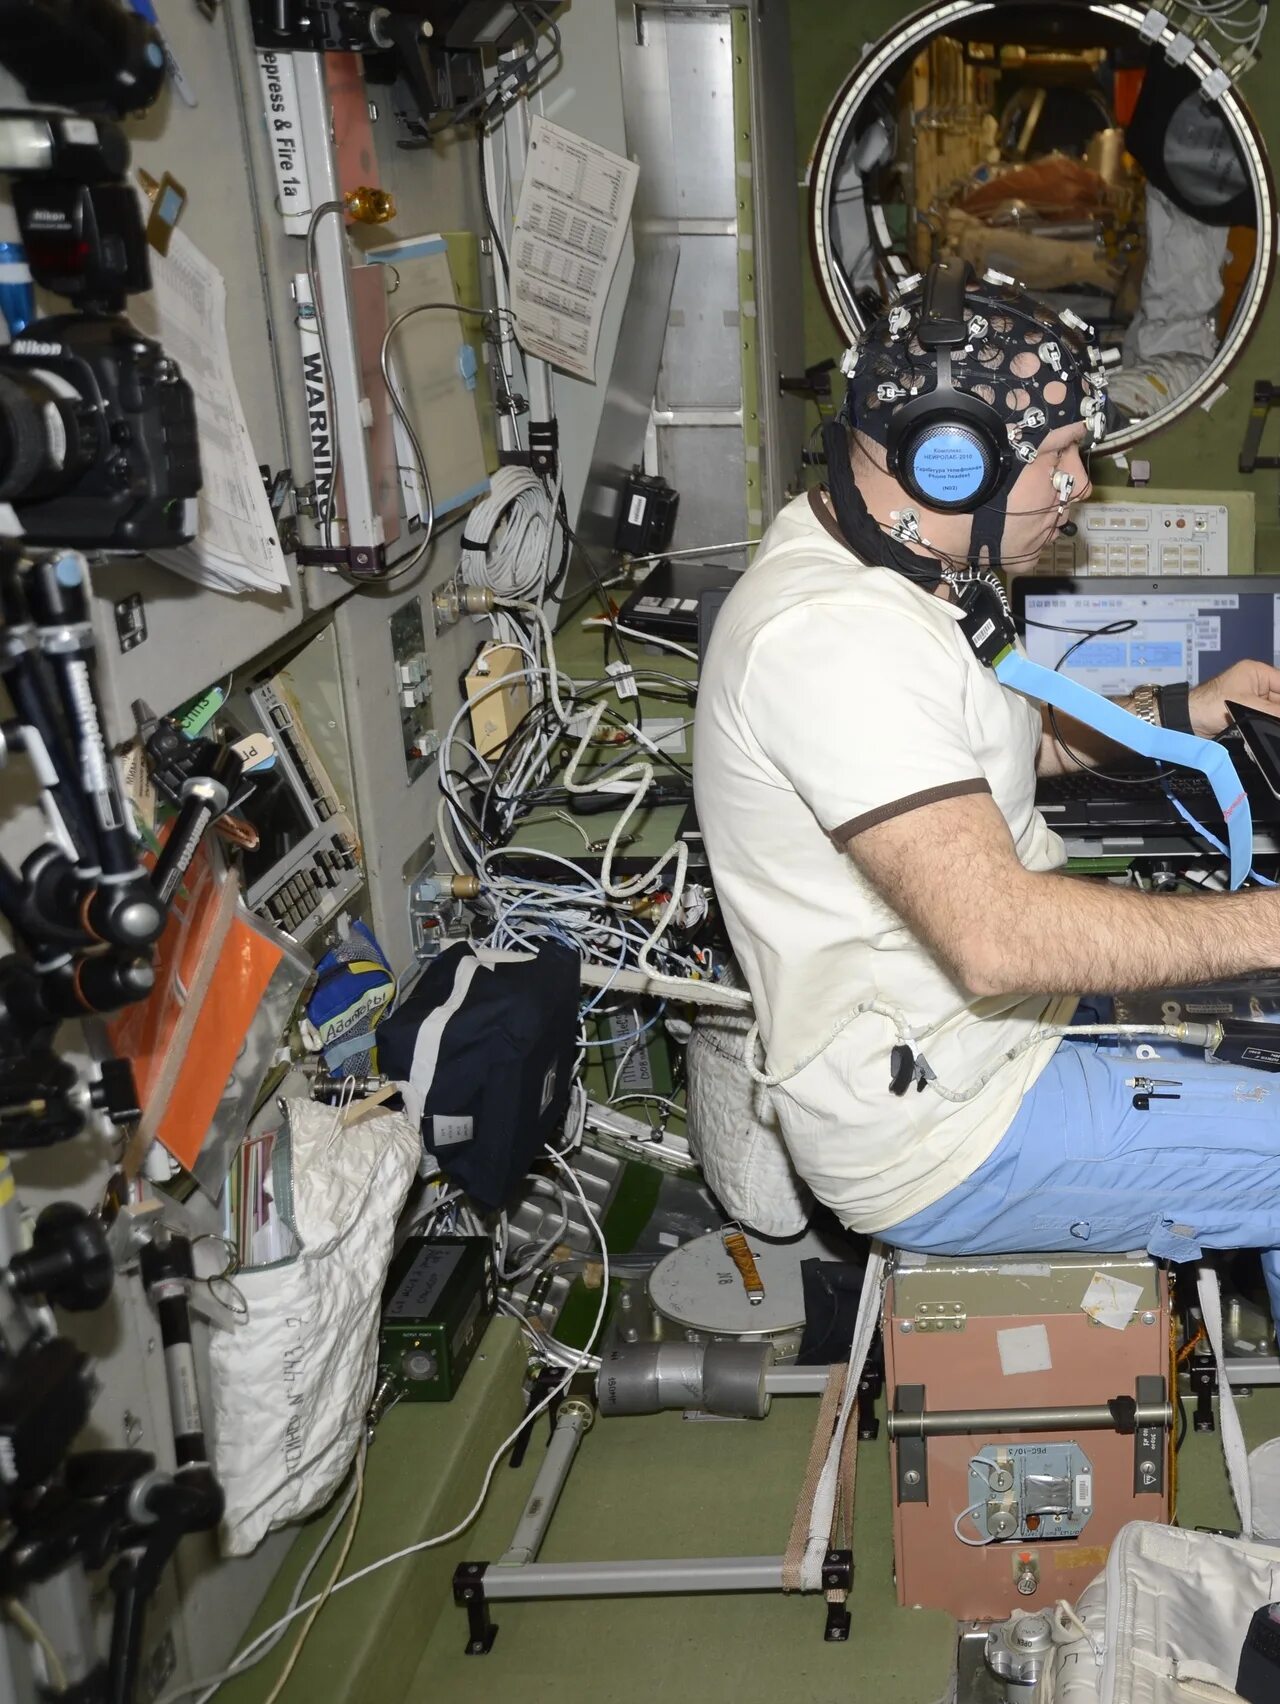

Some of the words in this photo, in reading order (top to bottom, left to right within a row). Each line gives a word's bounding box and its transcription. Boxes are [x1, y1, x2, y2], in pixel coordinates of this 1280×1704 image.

[274, 119, 292, 131] &
[277, 138, 296, 171] Fire
[283, 176, 301, 197] 1a
[33, 210, 65, 222] Nikon
[12, 340, 62, 356] Nikon
[304, 352, 336, 522] WARNING
[1017, 1638, 1033, 1648] OPEN
